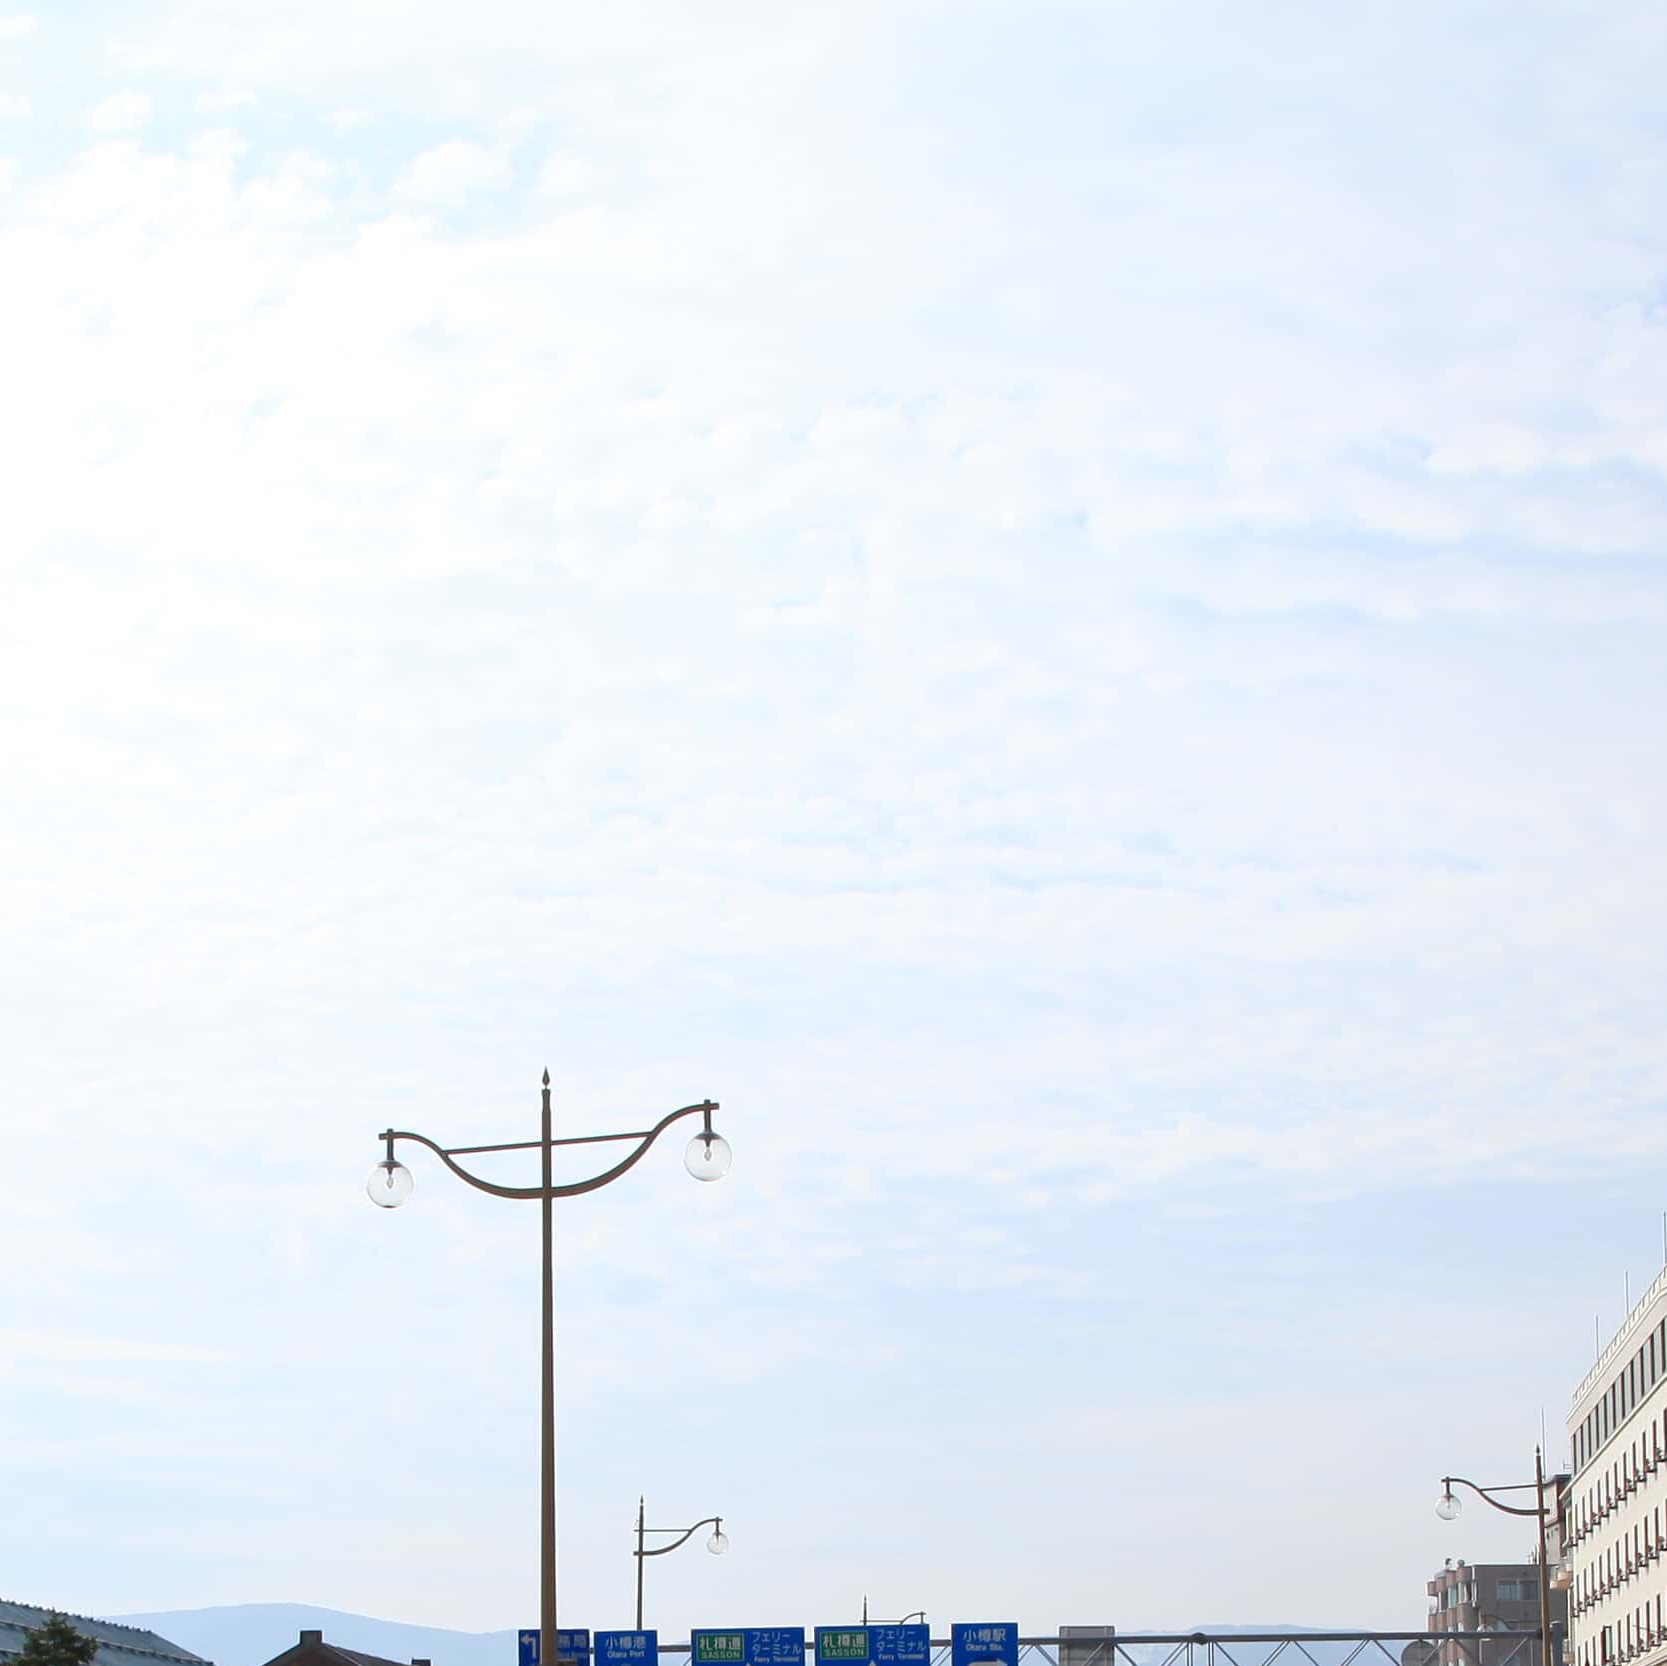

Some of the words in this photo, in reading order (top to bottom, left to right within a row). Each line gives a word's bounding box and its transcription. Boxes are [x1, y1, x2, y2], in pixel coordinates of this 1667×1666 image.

[752, 1631, 791, 1641] フェリー
[877, 1628, 916, 1640] フェリー
[963, 1628, 1007, 1642] 小樽駅
[605, 1635, 647, 1650] 小樽港
[752, 1642, 802, 1655] ターミナル
[876, 1640, 927, 1653] ターミナル
[629, 1649, 645, 1658] Port
[701, 1650, 741, 1660] SASSON
[825, 1648, 865, 1657] SASSON
